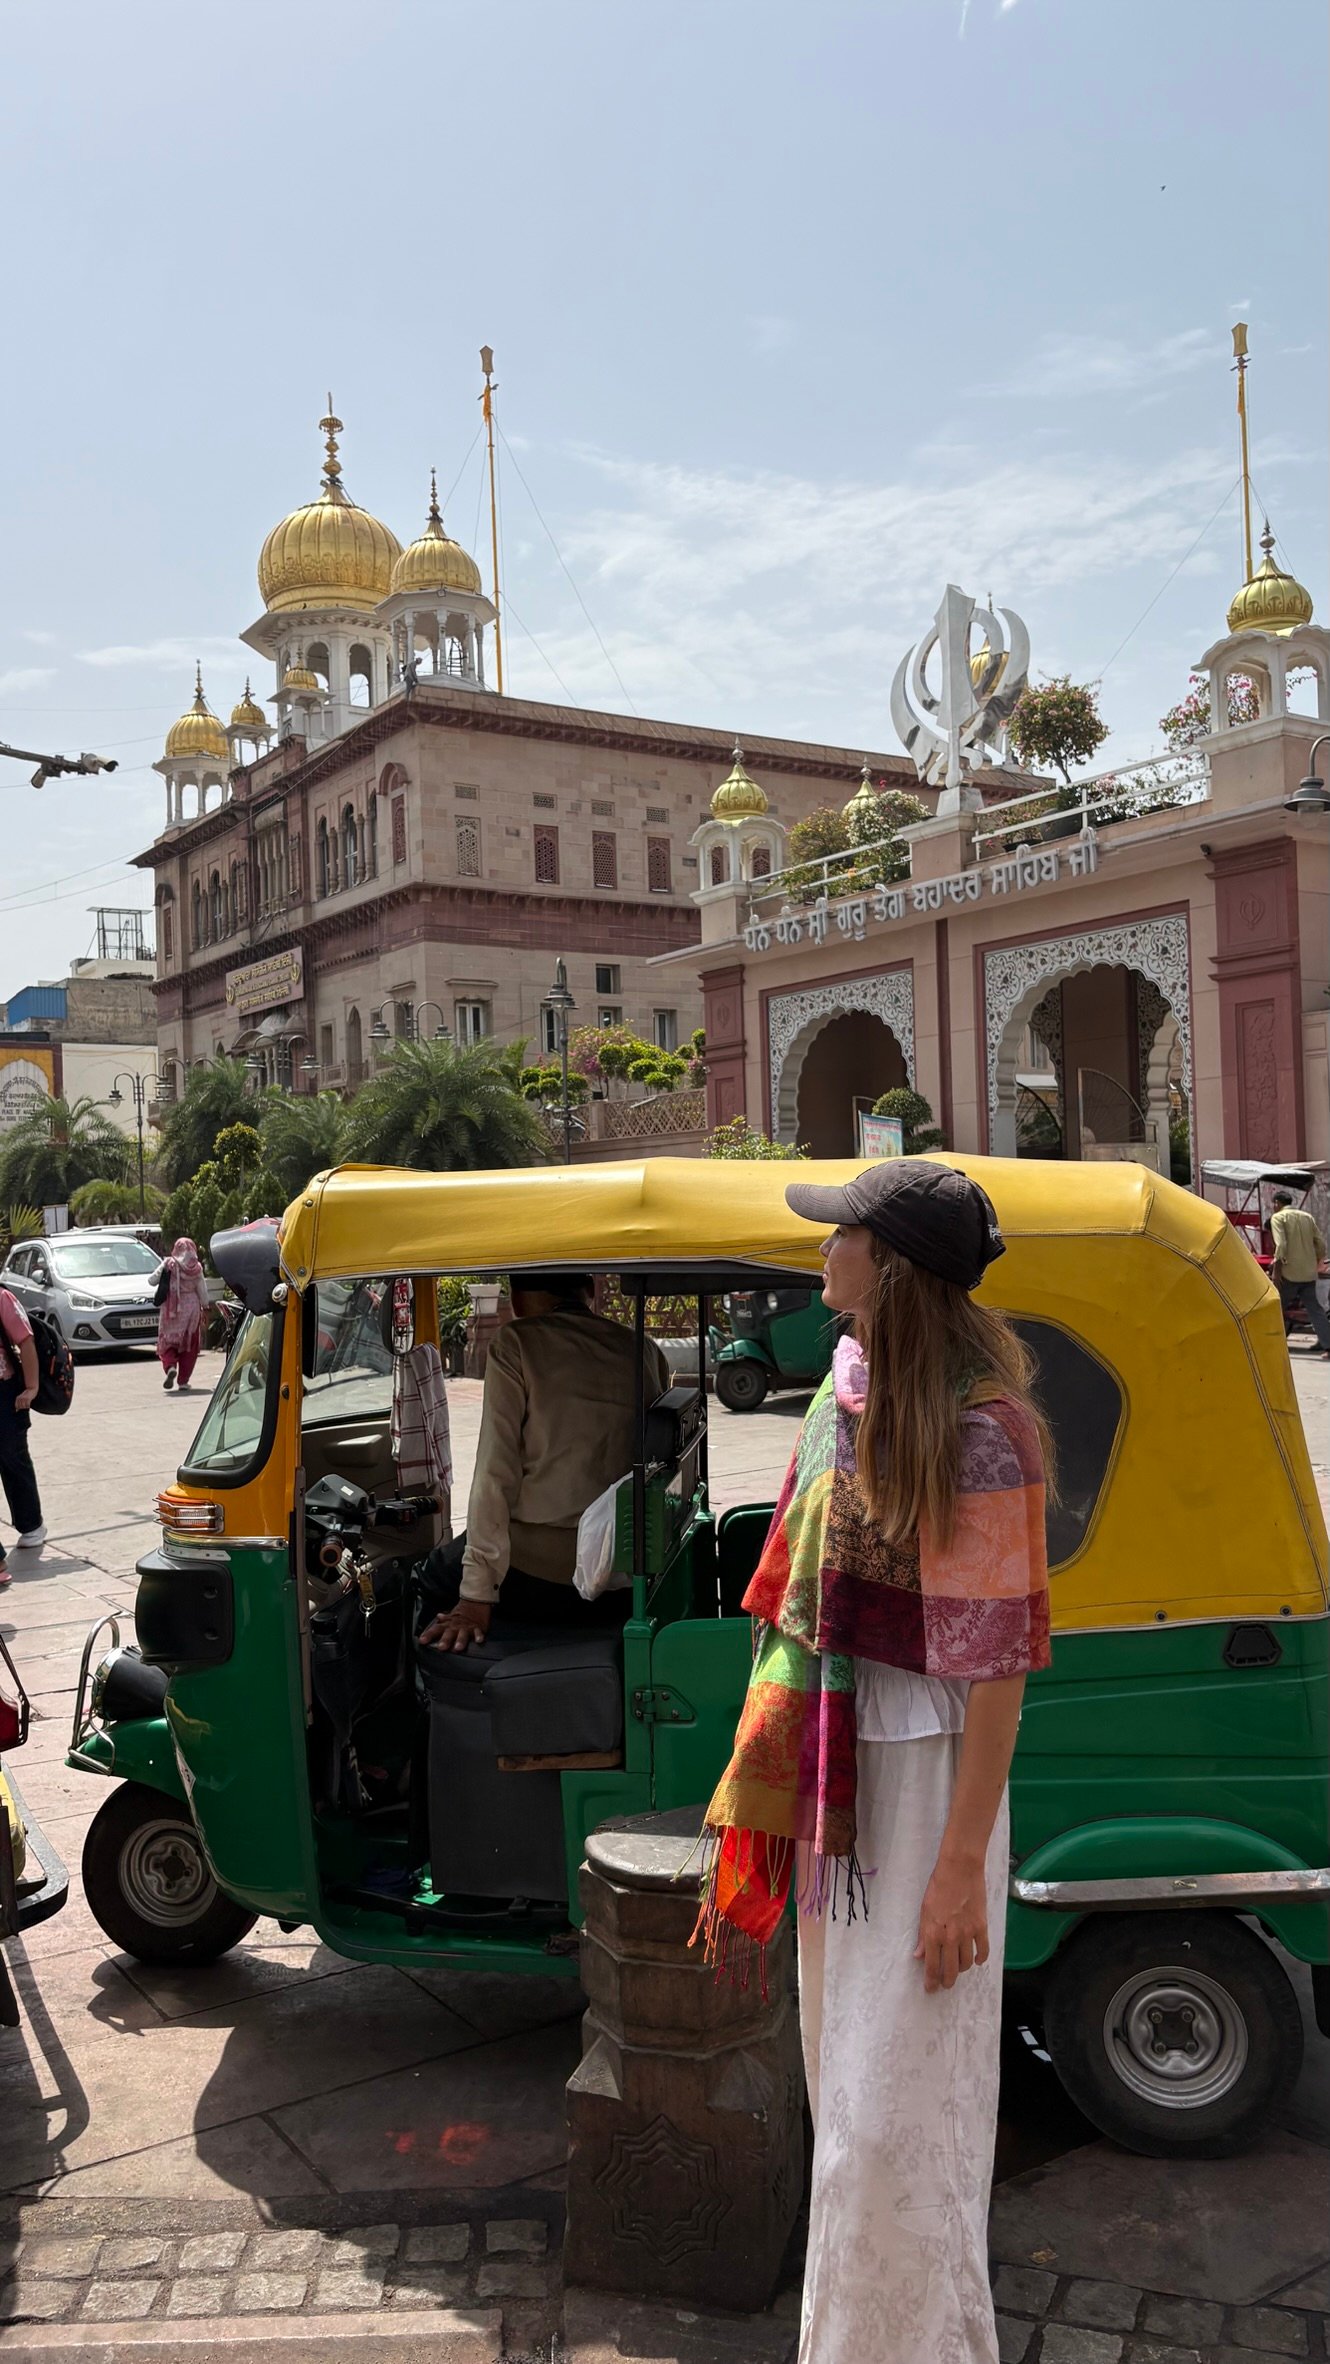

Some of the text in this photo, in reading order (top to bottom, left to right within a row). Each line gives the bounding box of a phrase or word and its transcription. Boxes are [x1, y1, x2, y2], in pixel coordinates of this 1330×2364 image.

[911, 868, 982, 912] ਬਹਾਦਰ
[990, 843, 1060, 895] ਸਾਹਿਬ
[1068, 826, 1098, 877] ਜੀ
